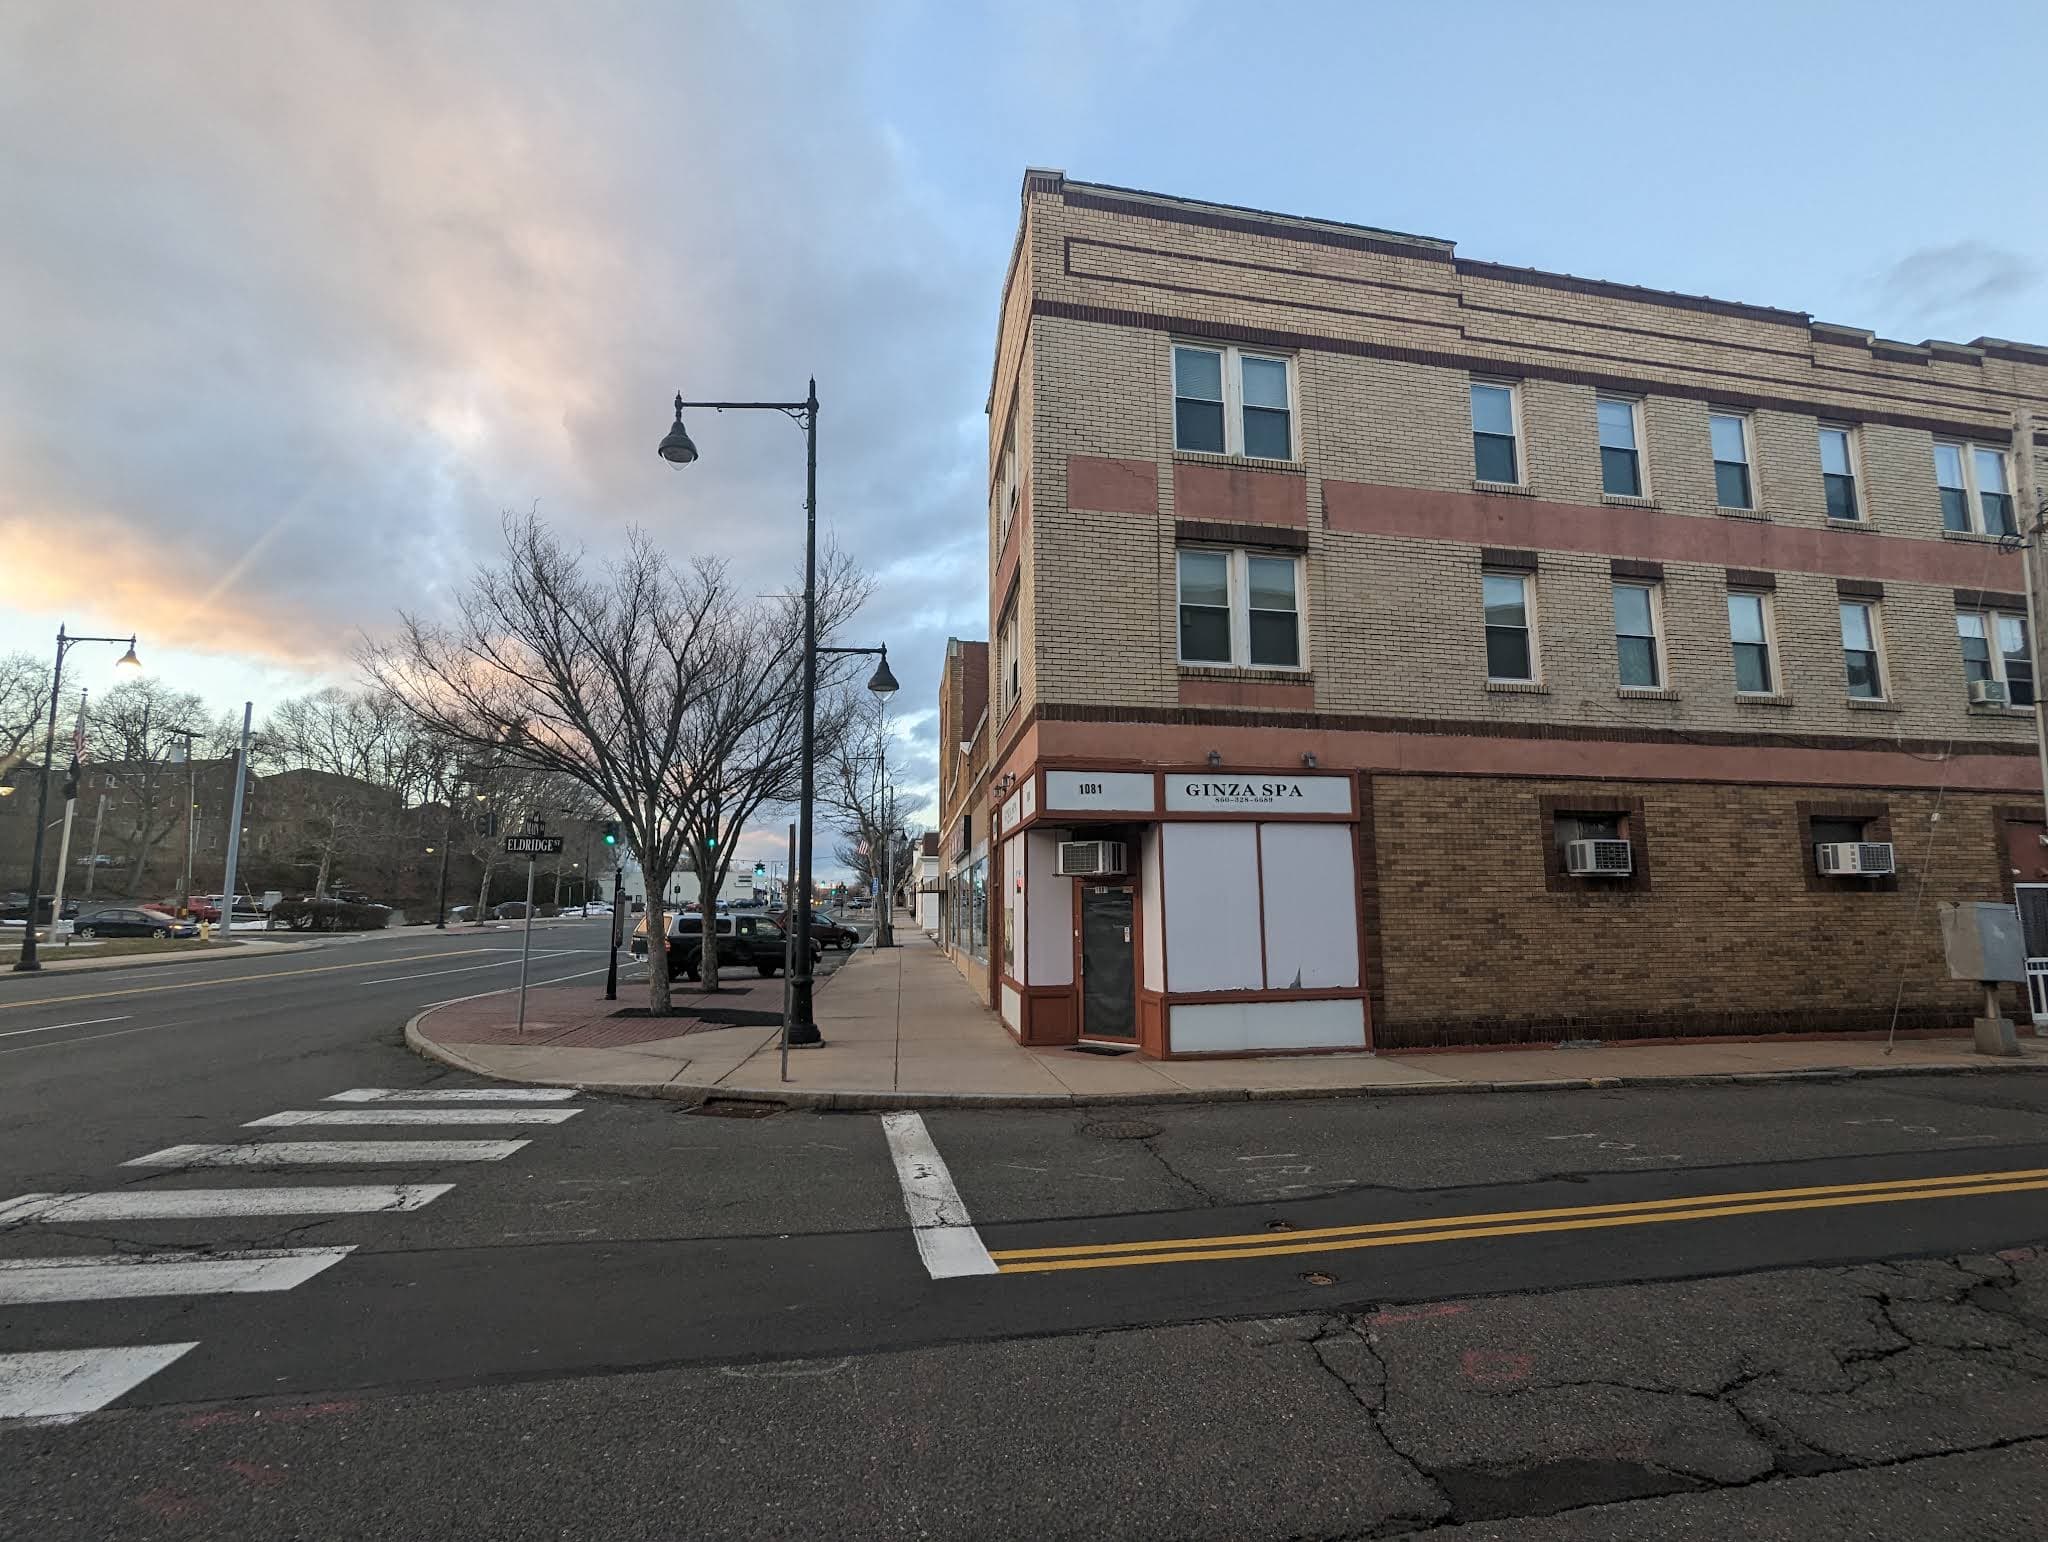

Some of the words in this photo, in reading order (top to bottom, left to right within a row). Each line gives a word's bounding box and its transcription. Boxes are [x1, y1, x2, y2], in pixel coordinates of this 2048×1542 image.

[1079, 783, 1102, 795] 1081
[1185, 783, 1256, 797] GINZA
[1262, 784, 1304, 798] SPA
[507, 838, 553, 852] ELDRIDGE
